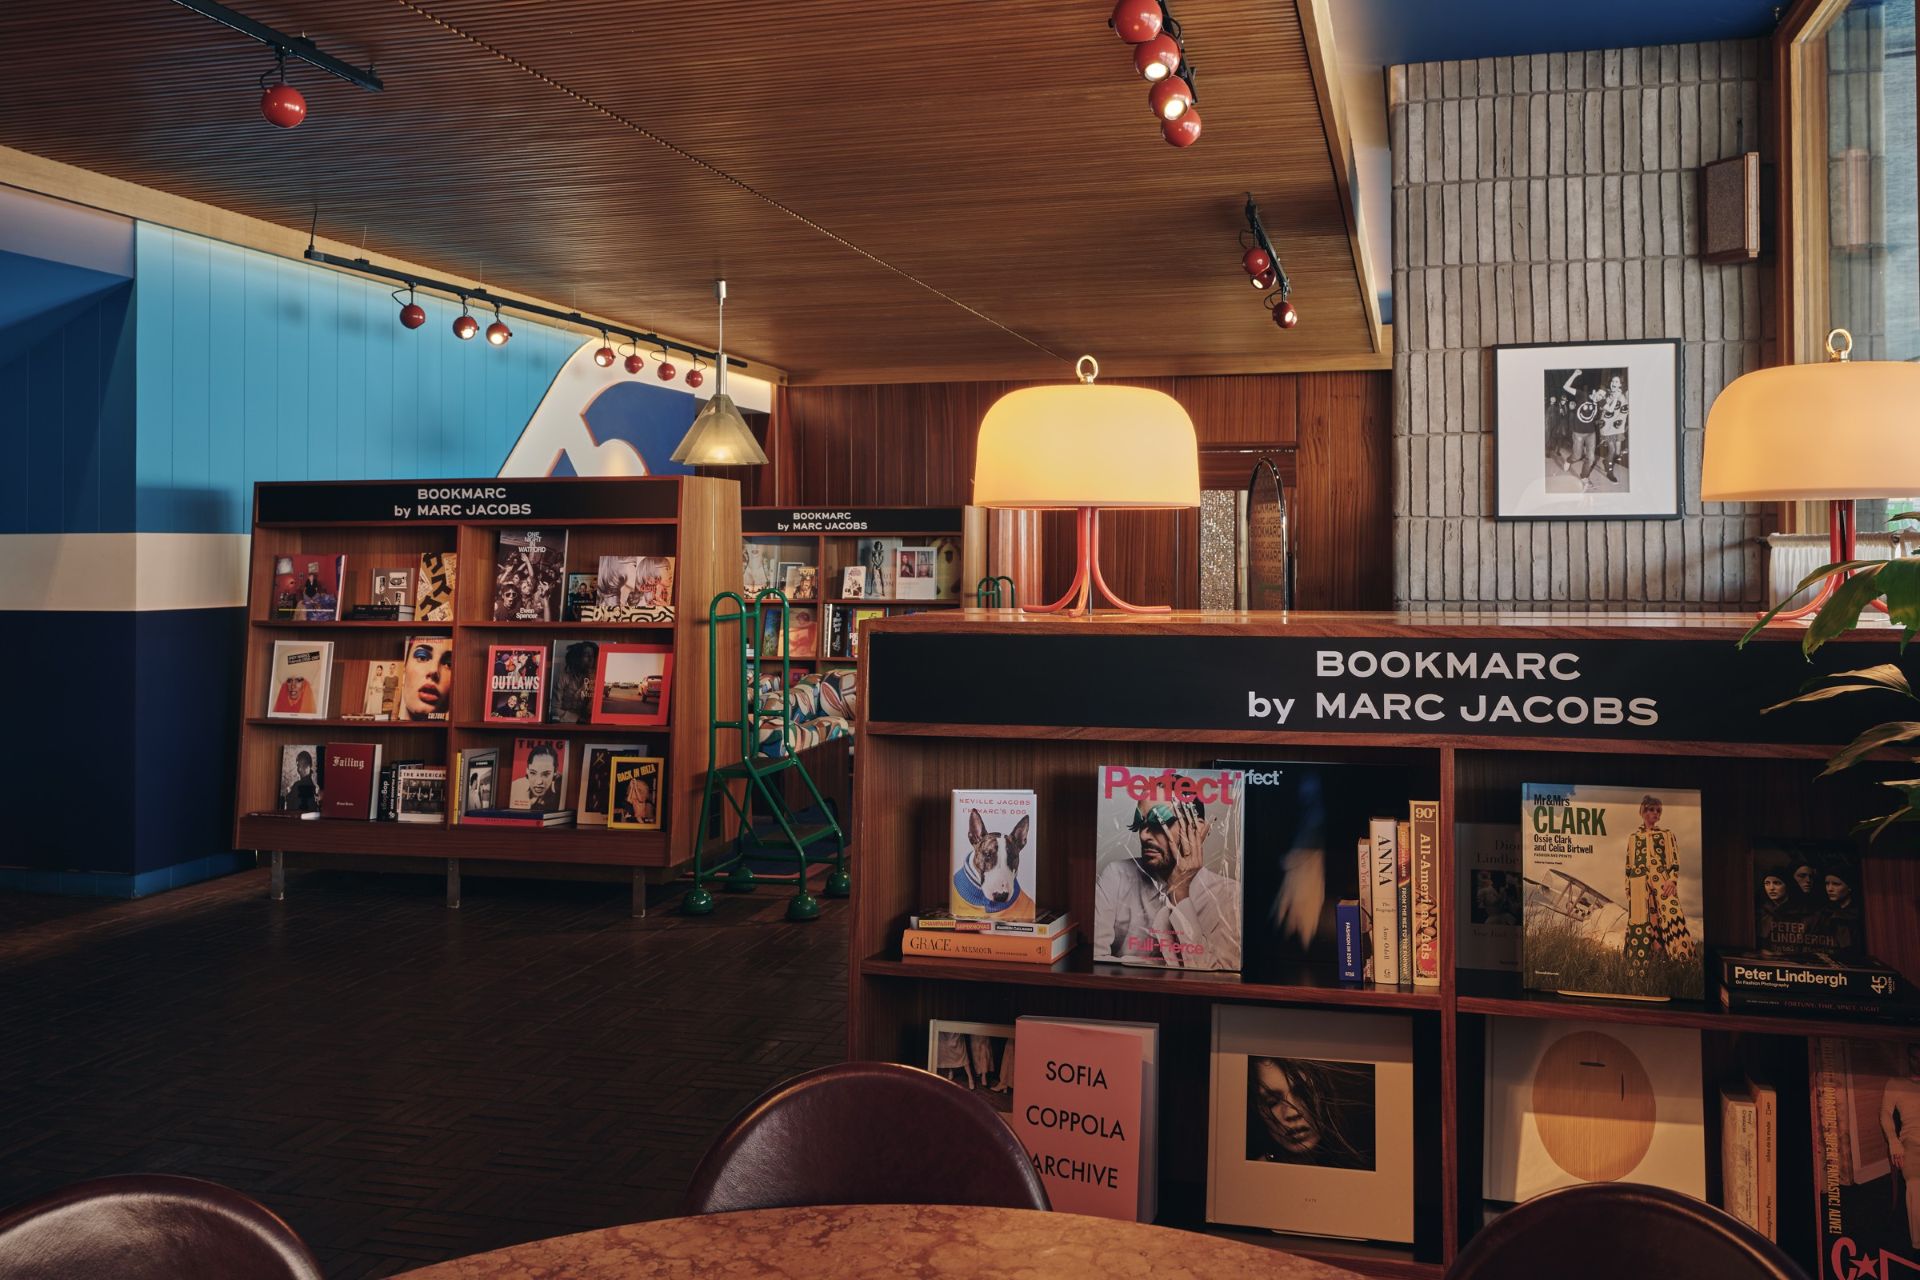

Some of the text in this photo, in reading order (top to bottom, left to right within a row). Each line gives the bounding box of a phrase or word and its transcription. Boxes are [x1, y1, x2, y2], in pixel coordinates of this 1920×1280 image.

[417, 488, 506, 500] BOOKMARC
[394, 503, 532, 518] by MARC JACOBS
[793, 512, 851, 520] BOOKMARC
[777, 523, 790, 532] by
[825, 522, 868, 530] JACOBS
[1316, 650, 1581, 681] BOOKMARC
[491, 675, 540, 691] OUTLAWS
[1248, 691, 1659, 726] by MARC JACOBS
[518, 738, 564, 750] THING
[616, 770, 633, 782] BACK
[1104, 765, 1234, 805] Perfect
[1244, 770, 1280, 786] rfect
[1534, 794, 1570, 806] Mr&Mrs
[1533, 806, 1607, 836] CLARK
[1534, 834, 1572, 844] Ossie Clark
[1534, 843, 1593, 854] and Celia Birtwell
[1378, 835, 1393, 886] ANNA
[1360, 869, 1368, 889] York
[910, 937, 952, 952] GRACE
[962, 946, 992, 954] MEMOIR
[1127, 936, 1204, 955] Full-Fierce
[1734, 966, 1848, 988] Peter Lindbergh
[1870, 975, 1888, 994] 45
[1046, 1060, 1108, 1090] SOFIA
[1026, 1105, 1125, 1141] COPPOLA
[1032, 1153, 1118, 1189] ARCHIVE
[1827, 1164, 1841, 1206] FANTASTIC!
[1829, 1208, 1842, 1234] ALIVE!
